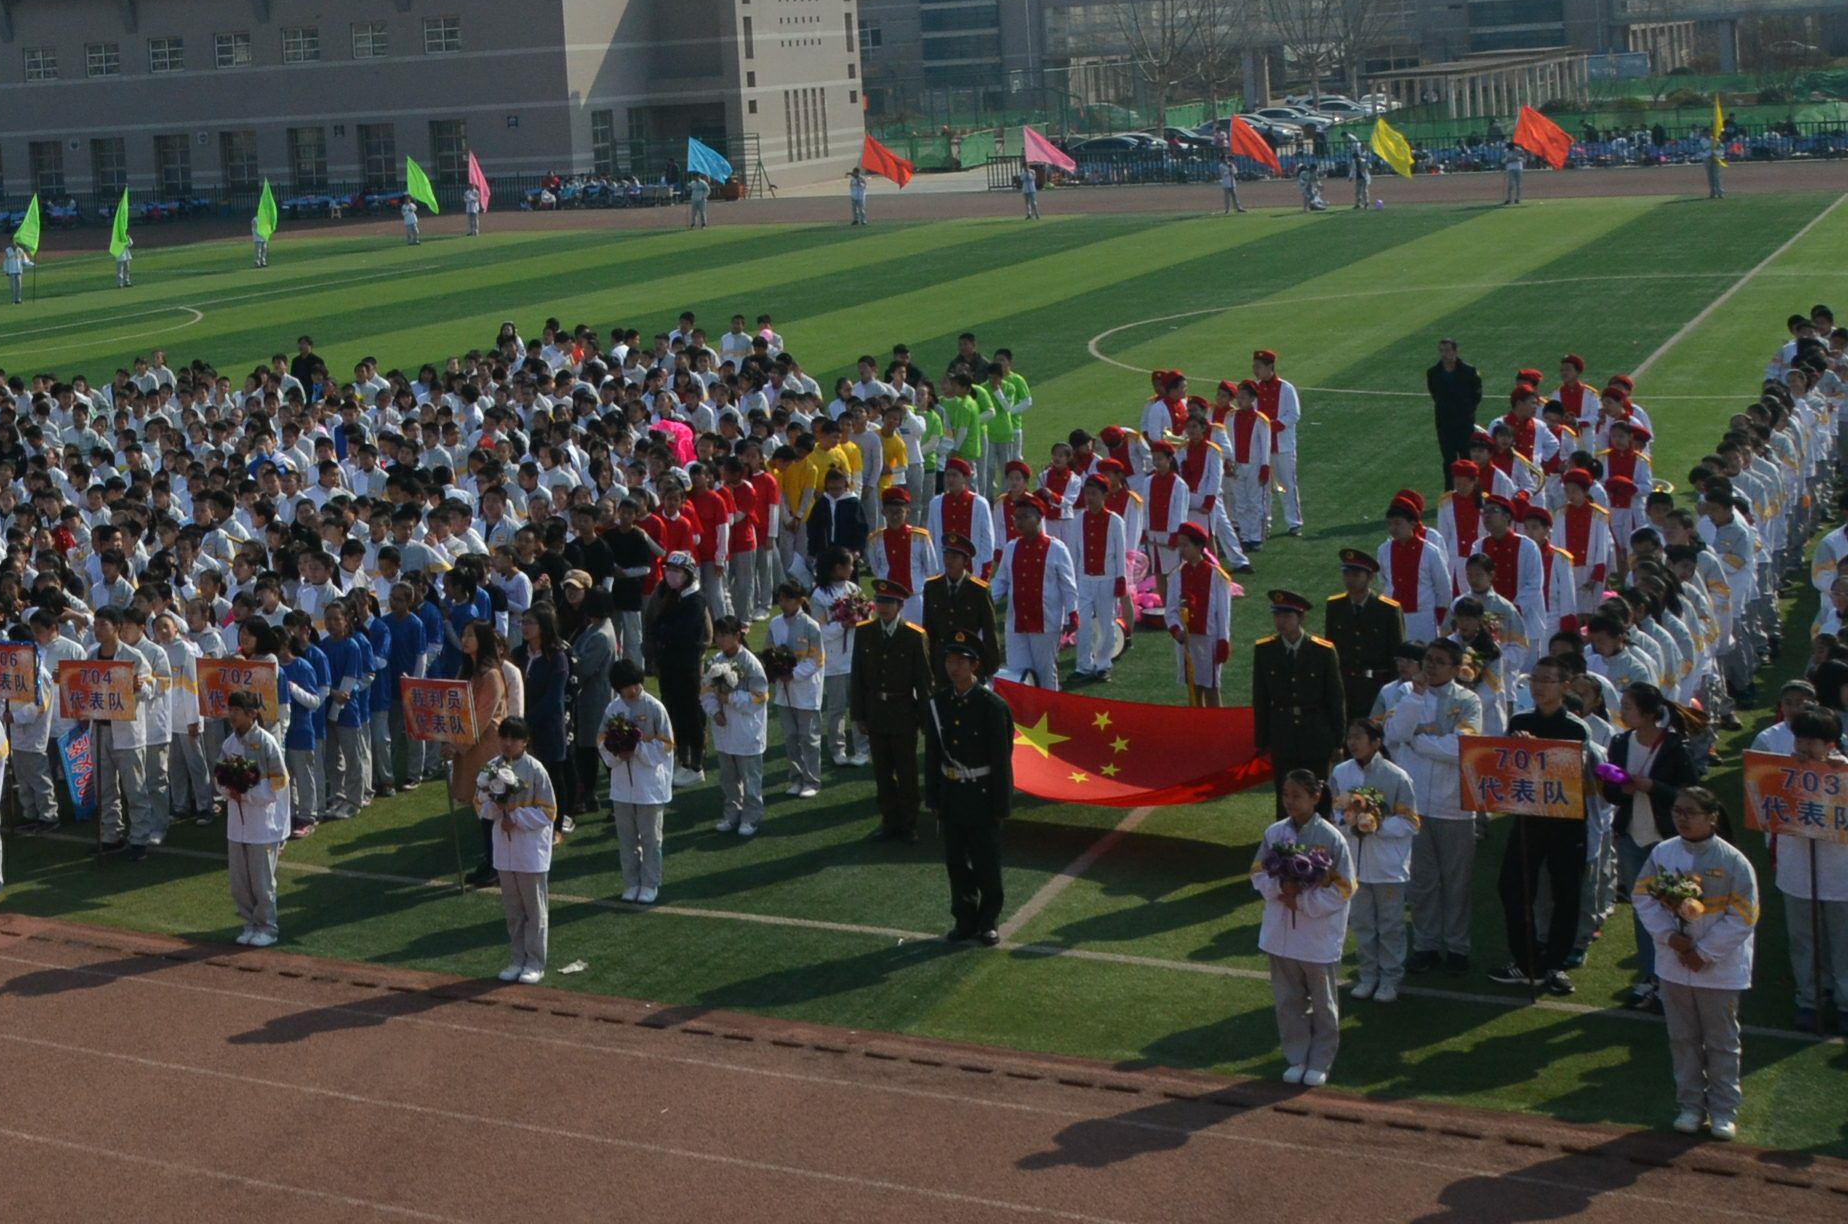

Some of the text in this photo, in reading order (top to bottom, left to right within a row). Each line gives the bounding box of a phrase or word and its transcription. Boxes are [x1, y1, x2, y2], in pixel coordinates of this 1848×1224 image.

[80, 669, 113, 685] 704
[218, 668, 253, 686] 702
[69, 691, 125, 712] 代表队
[410, 687, 462, 710] 裁判员
[414, 713, 466, 735] 代表队
[1495, 748, 1547, 772] 701
[1478, 776, 1570, 805] 代表队
[1780, 767, 1841, 796] 703
